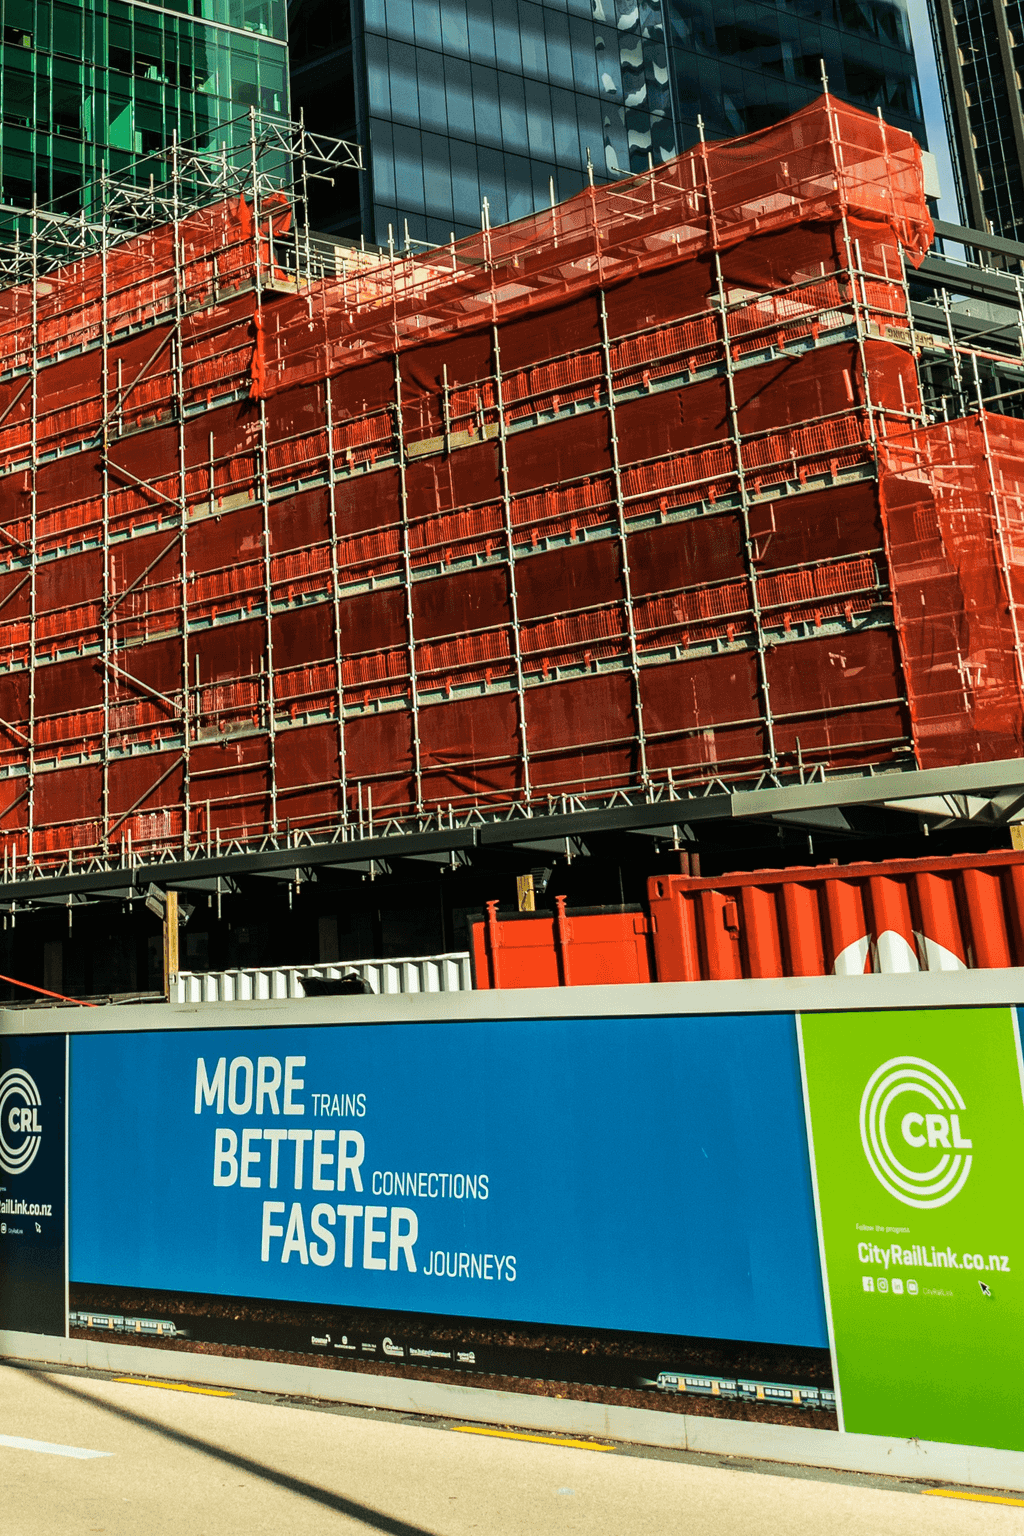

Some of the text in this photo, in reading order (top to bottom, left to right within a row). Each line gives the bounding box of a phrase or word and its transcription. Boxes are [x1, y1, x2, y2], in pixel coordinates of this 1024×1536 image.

[194, 1055, 366, 1117] MORE TRAINS
[8, 1107, 42, 1132] CRL
[901, 1112, 973, 1149] CRL
[213, 1128, 489, 1199] BETTER CONNECTIONS
[261, 1200, 517, 1282] FASTER JOURNEYS
[857, 1242, 1011, 1272] CityRailLink.co.nz
